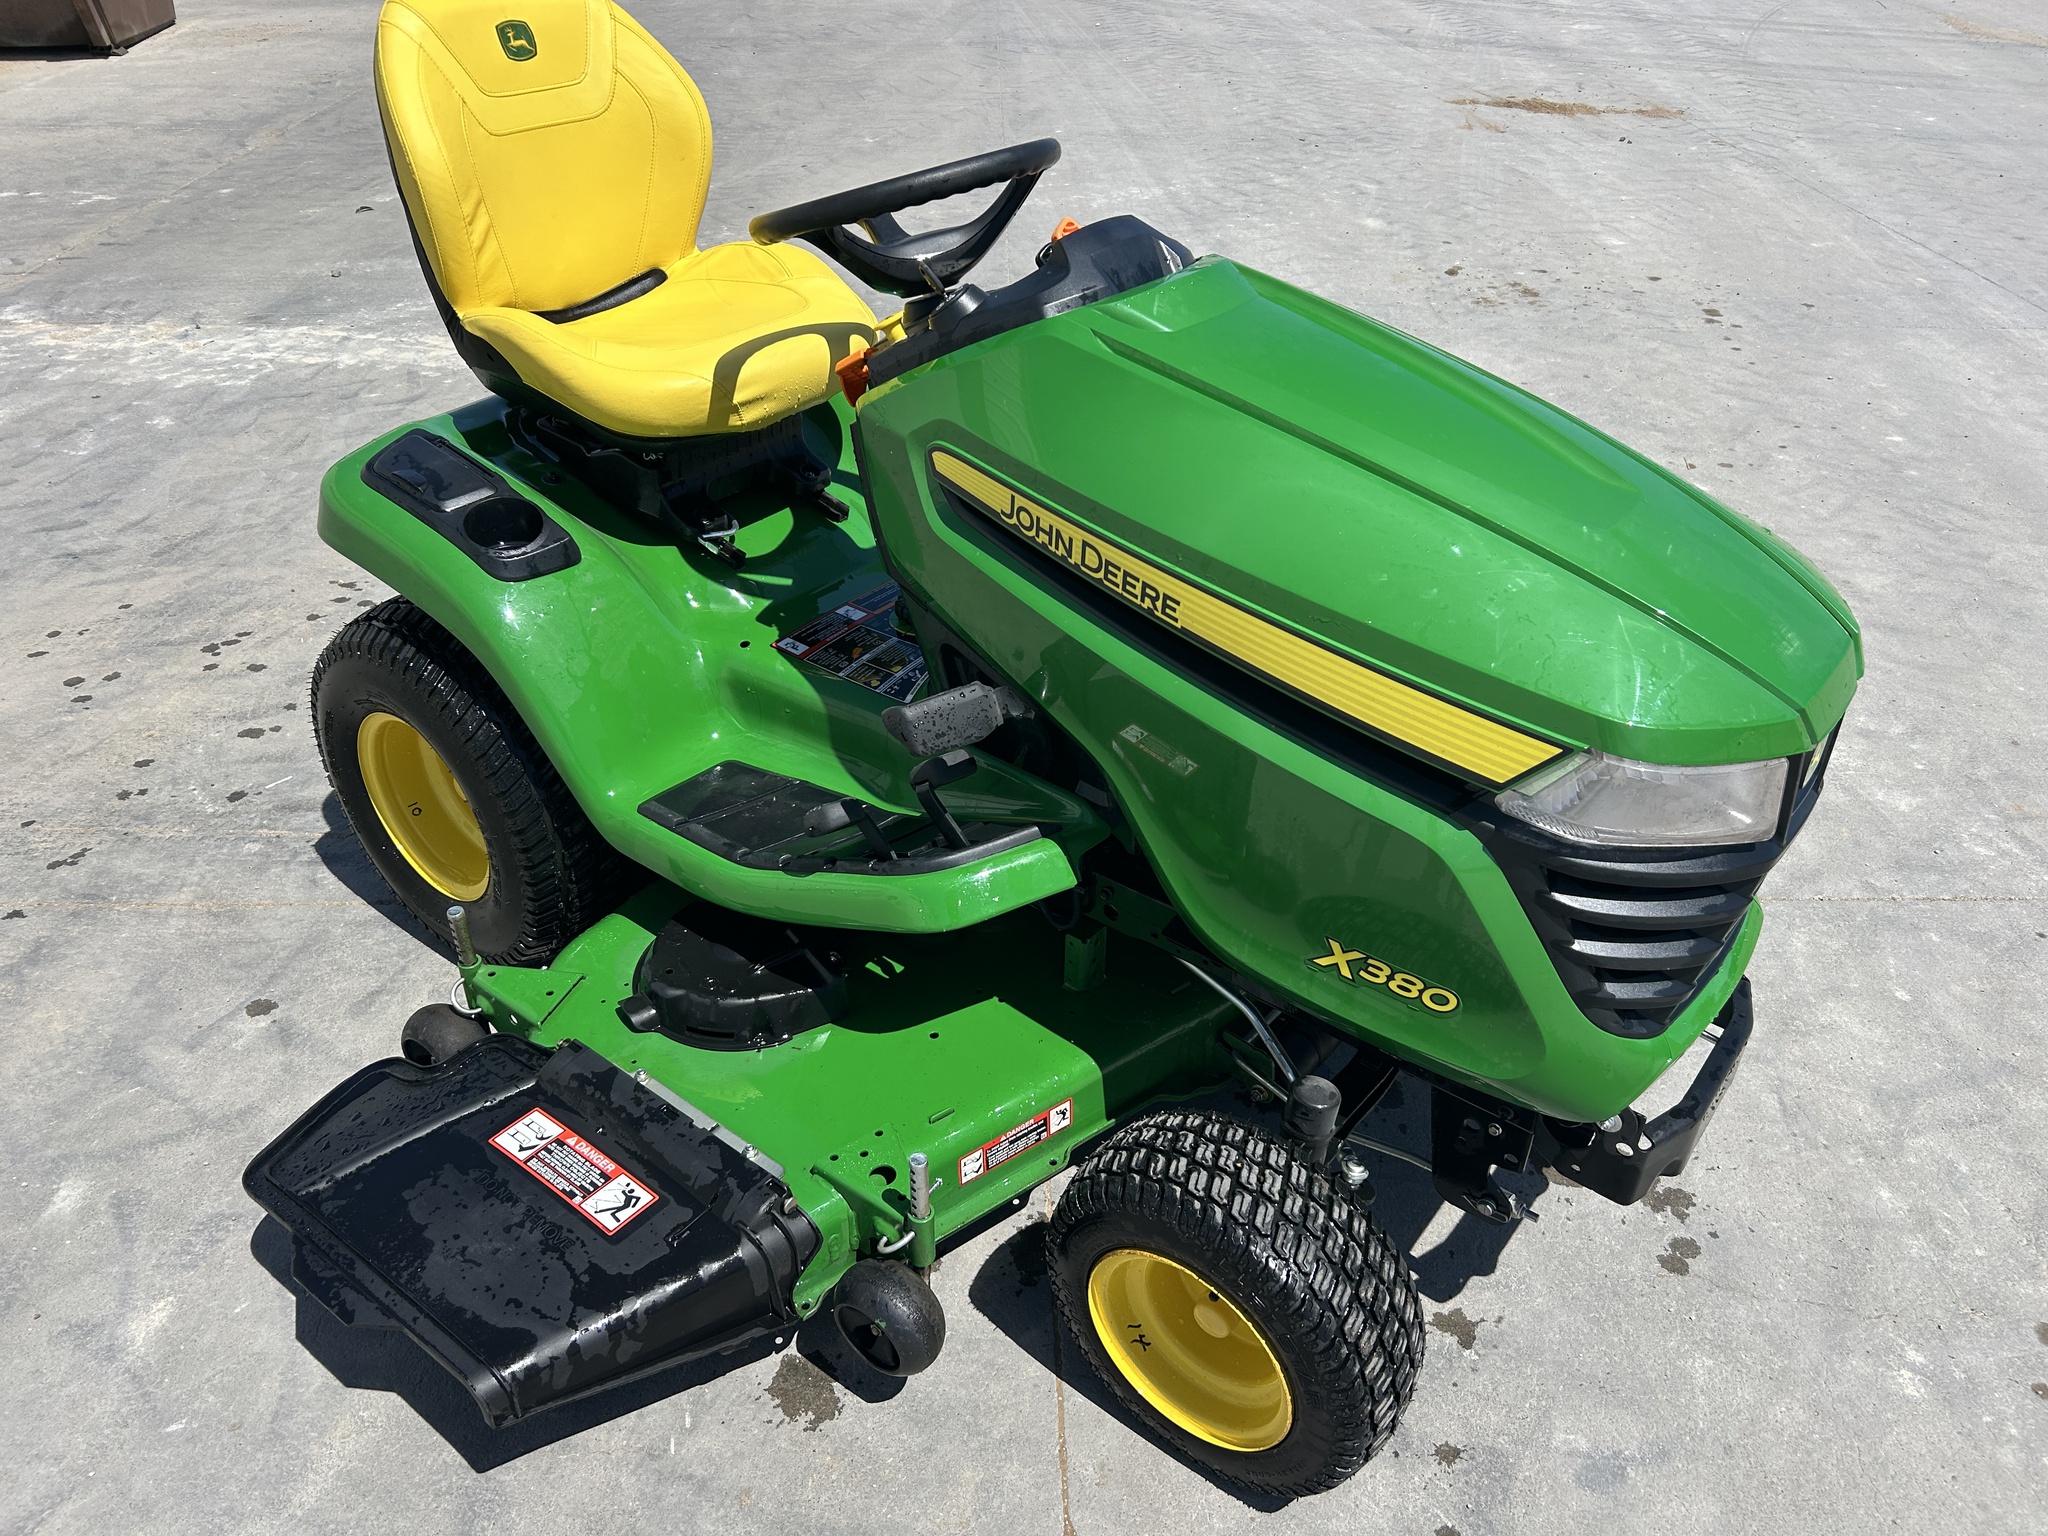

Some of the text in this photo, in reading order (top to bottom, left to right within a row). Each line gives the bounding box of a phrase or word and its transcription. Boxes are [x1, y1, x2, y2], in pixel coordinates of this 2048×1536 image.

[1000, 494, 1181, 624] JOHN DEERE
[1309, 936, 1459, 1013] X380
[574, 1141, 616, 1174] DANGER
[1006, 1118, 1035, 1139] DANGER
[477, 1171, 498, 1192] DO
[519, 1204, 576, 1252] REMOVE
